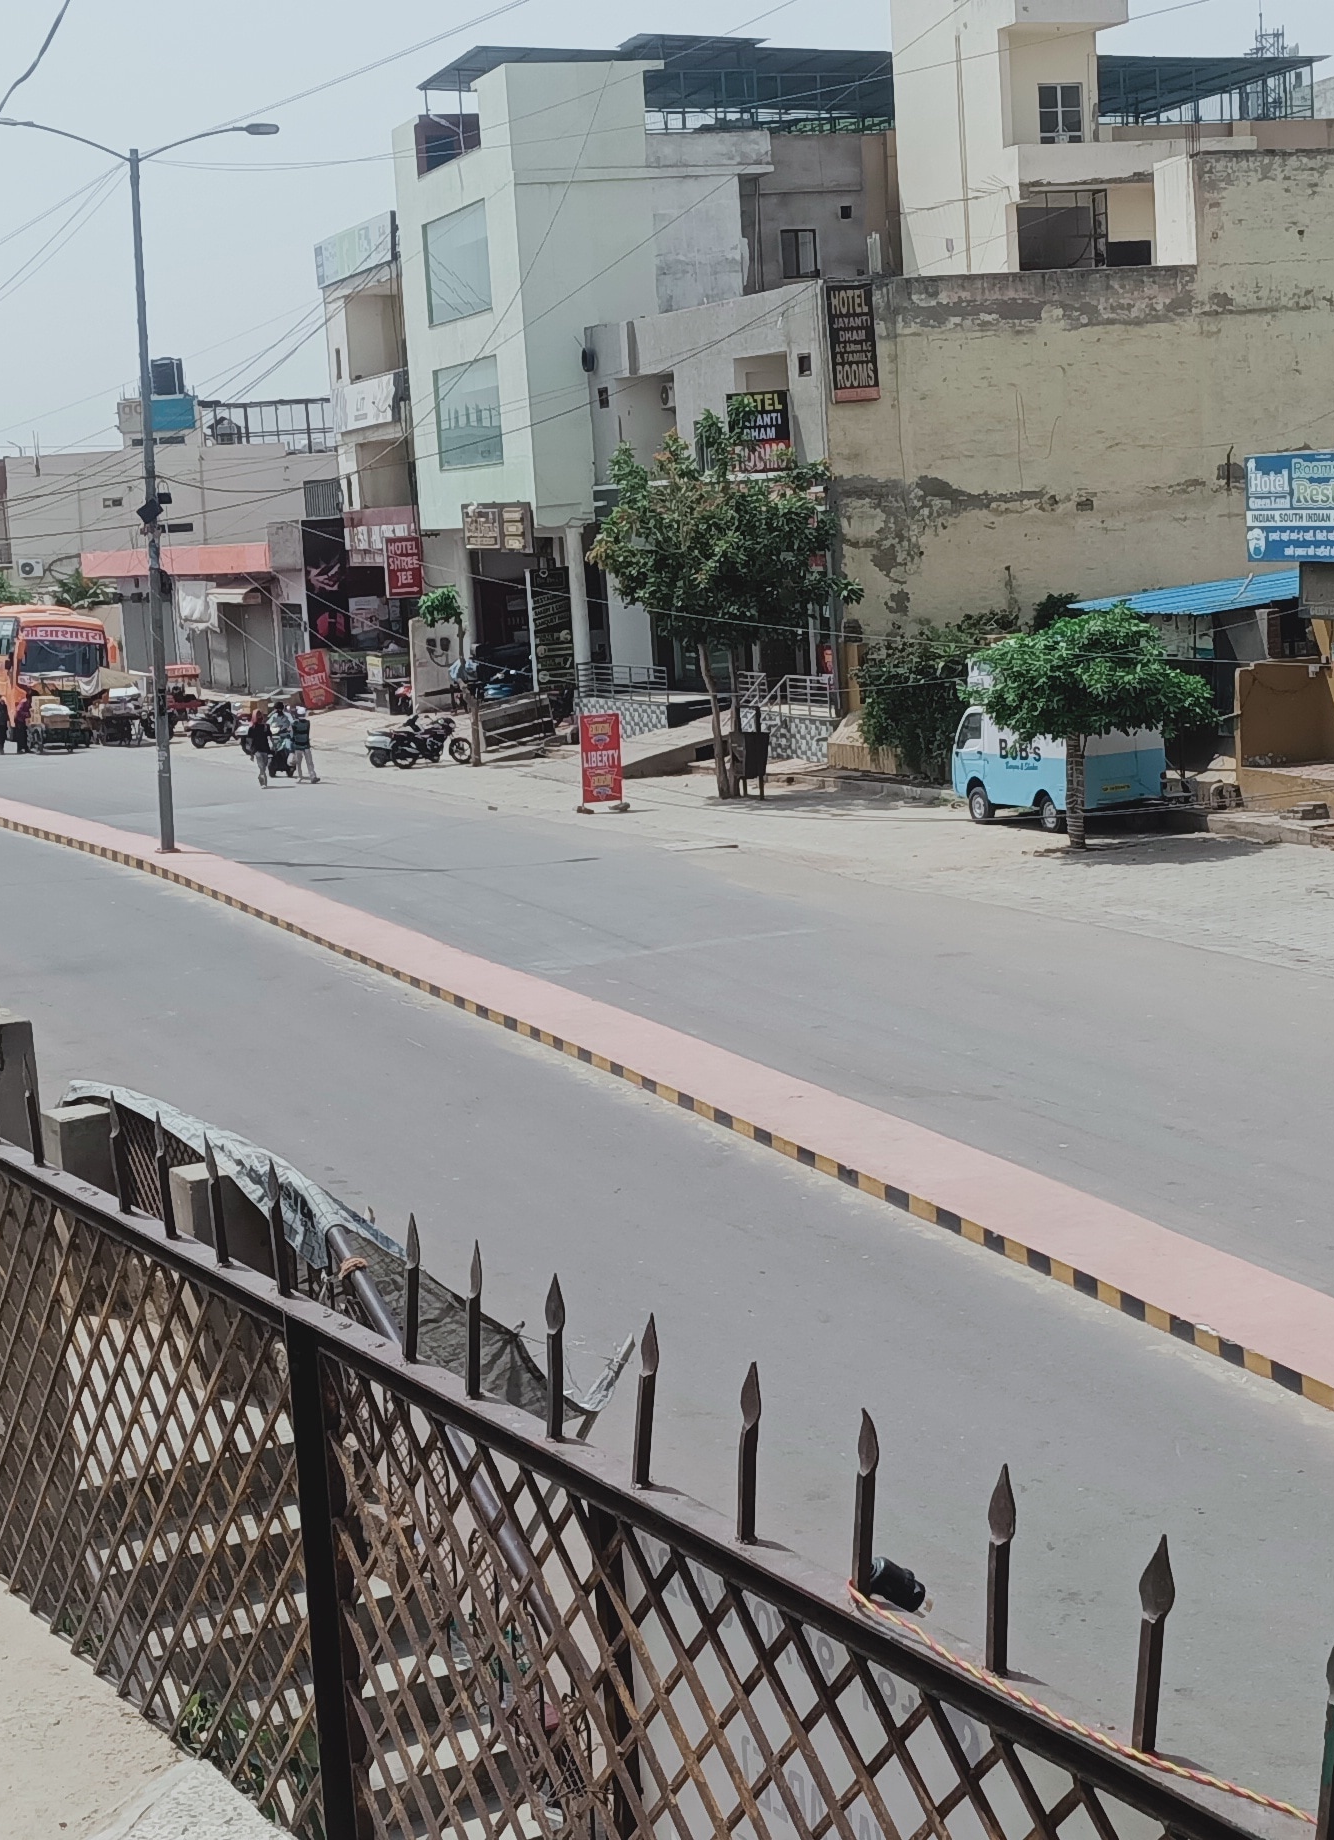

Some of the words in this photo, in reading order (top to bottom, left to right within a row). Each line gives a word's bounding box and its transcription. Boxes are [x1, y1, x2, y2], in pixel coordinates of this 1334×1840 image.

[830, 289, 869, 314] HOTEL
[833, 316, 871, 328] JAYANTI
[839, 330, 866, 341] DHAM
[836, 354, 842, 362] &
[844, 352, 872, 362] FAMILY
[836, 362, 875, 388] ROOMS
[1250, 468, 1290, 493] Hotel
[1279, 512, 1304, 523] SOUTH
[1305, 512, 1331, 523] INDIAN
[387, 541, 418, 554] HOTEL
[388, 555, 420, 570] SHREE
[396, 571, 414, 587] JEE
[39, 628, 102, 641] आशापुरा
[582, 749, 619, 769] LIBERTY
